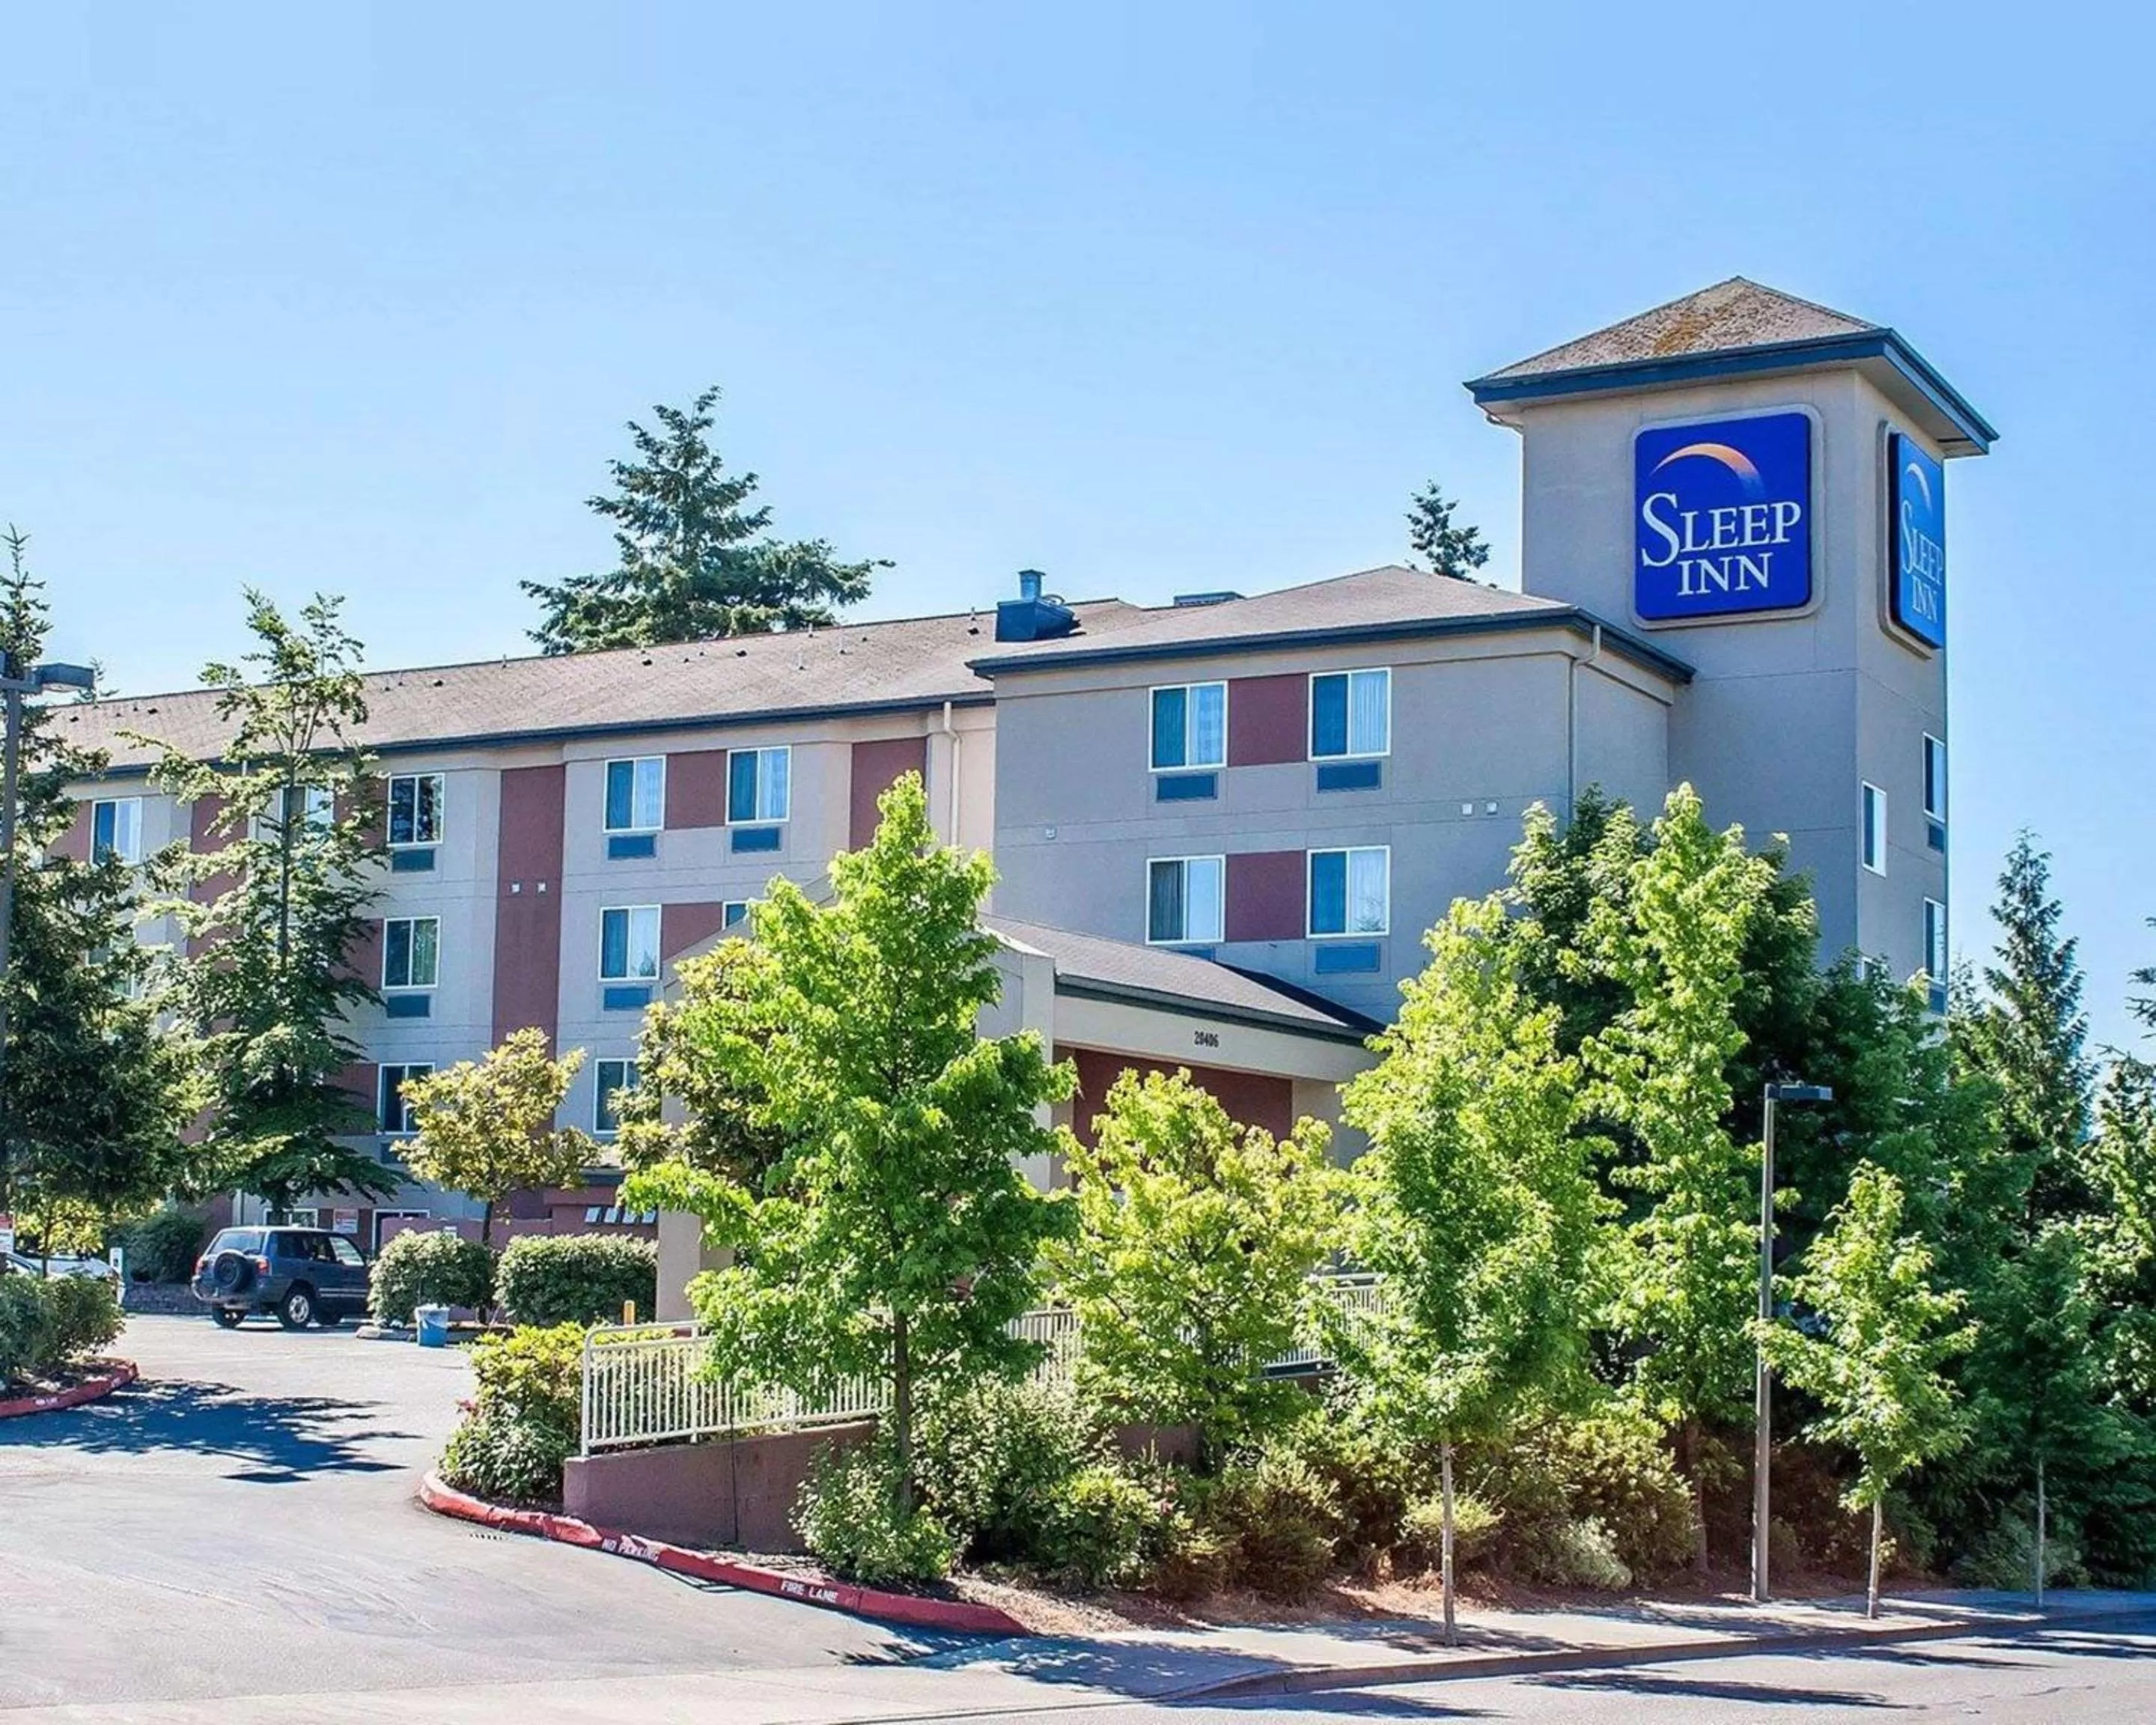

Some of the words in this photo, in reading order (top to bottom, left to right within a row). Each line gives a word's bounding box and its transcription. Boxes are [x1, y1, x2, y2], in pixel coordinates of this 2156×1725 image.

[1642, 493, 1801, 567] SLEEP
[1677, 552, 1773, 597] INN
[1911, 575, 1937, 623] INN
[602, 1538, 618, 1551] NO
[780, 1580, 805, 1596] FIRE
[808, 1586, 838, 1603] LANE
